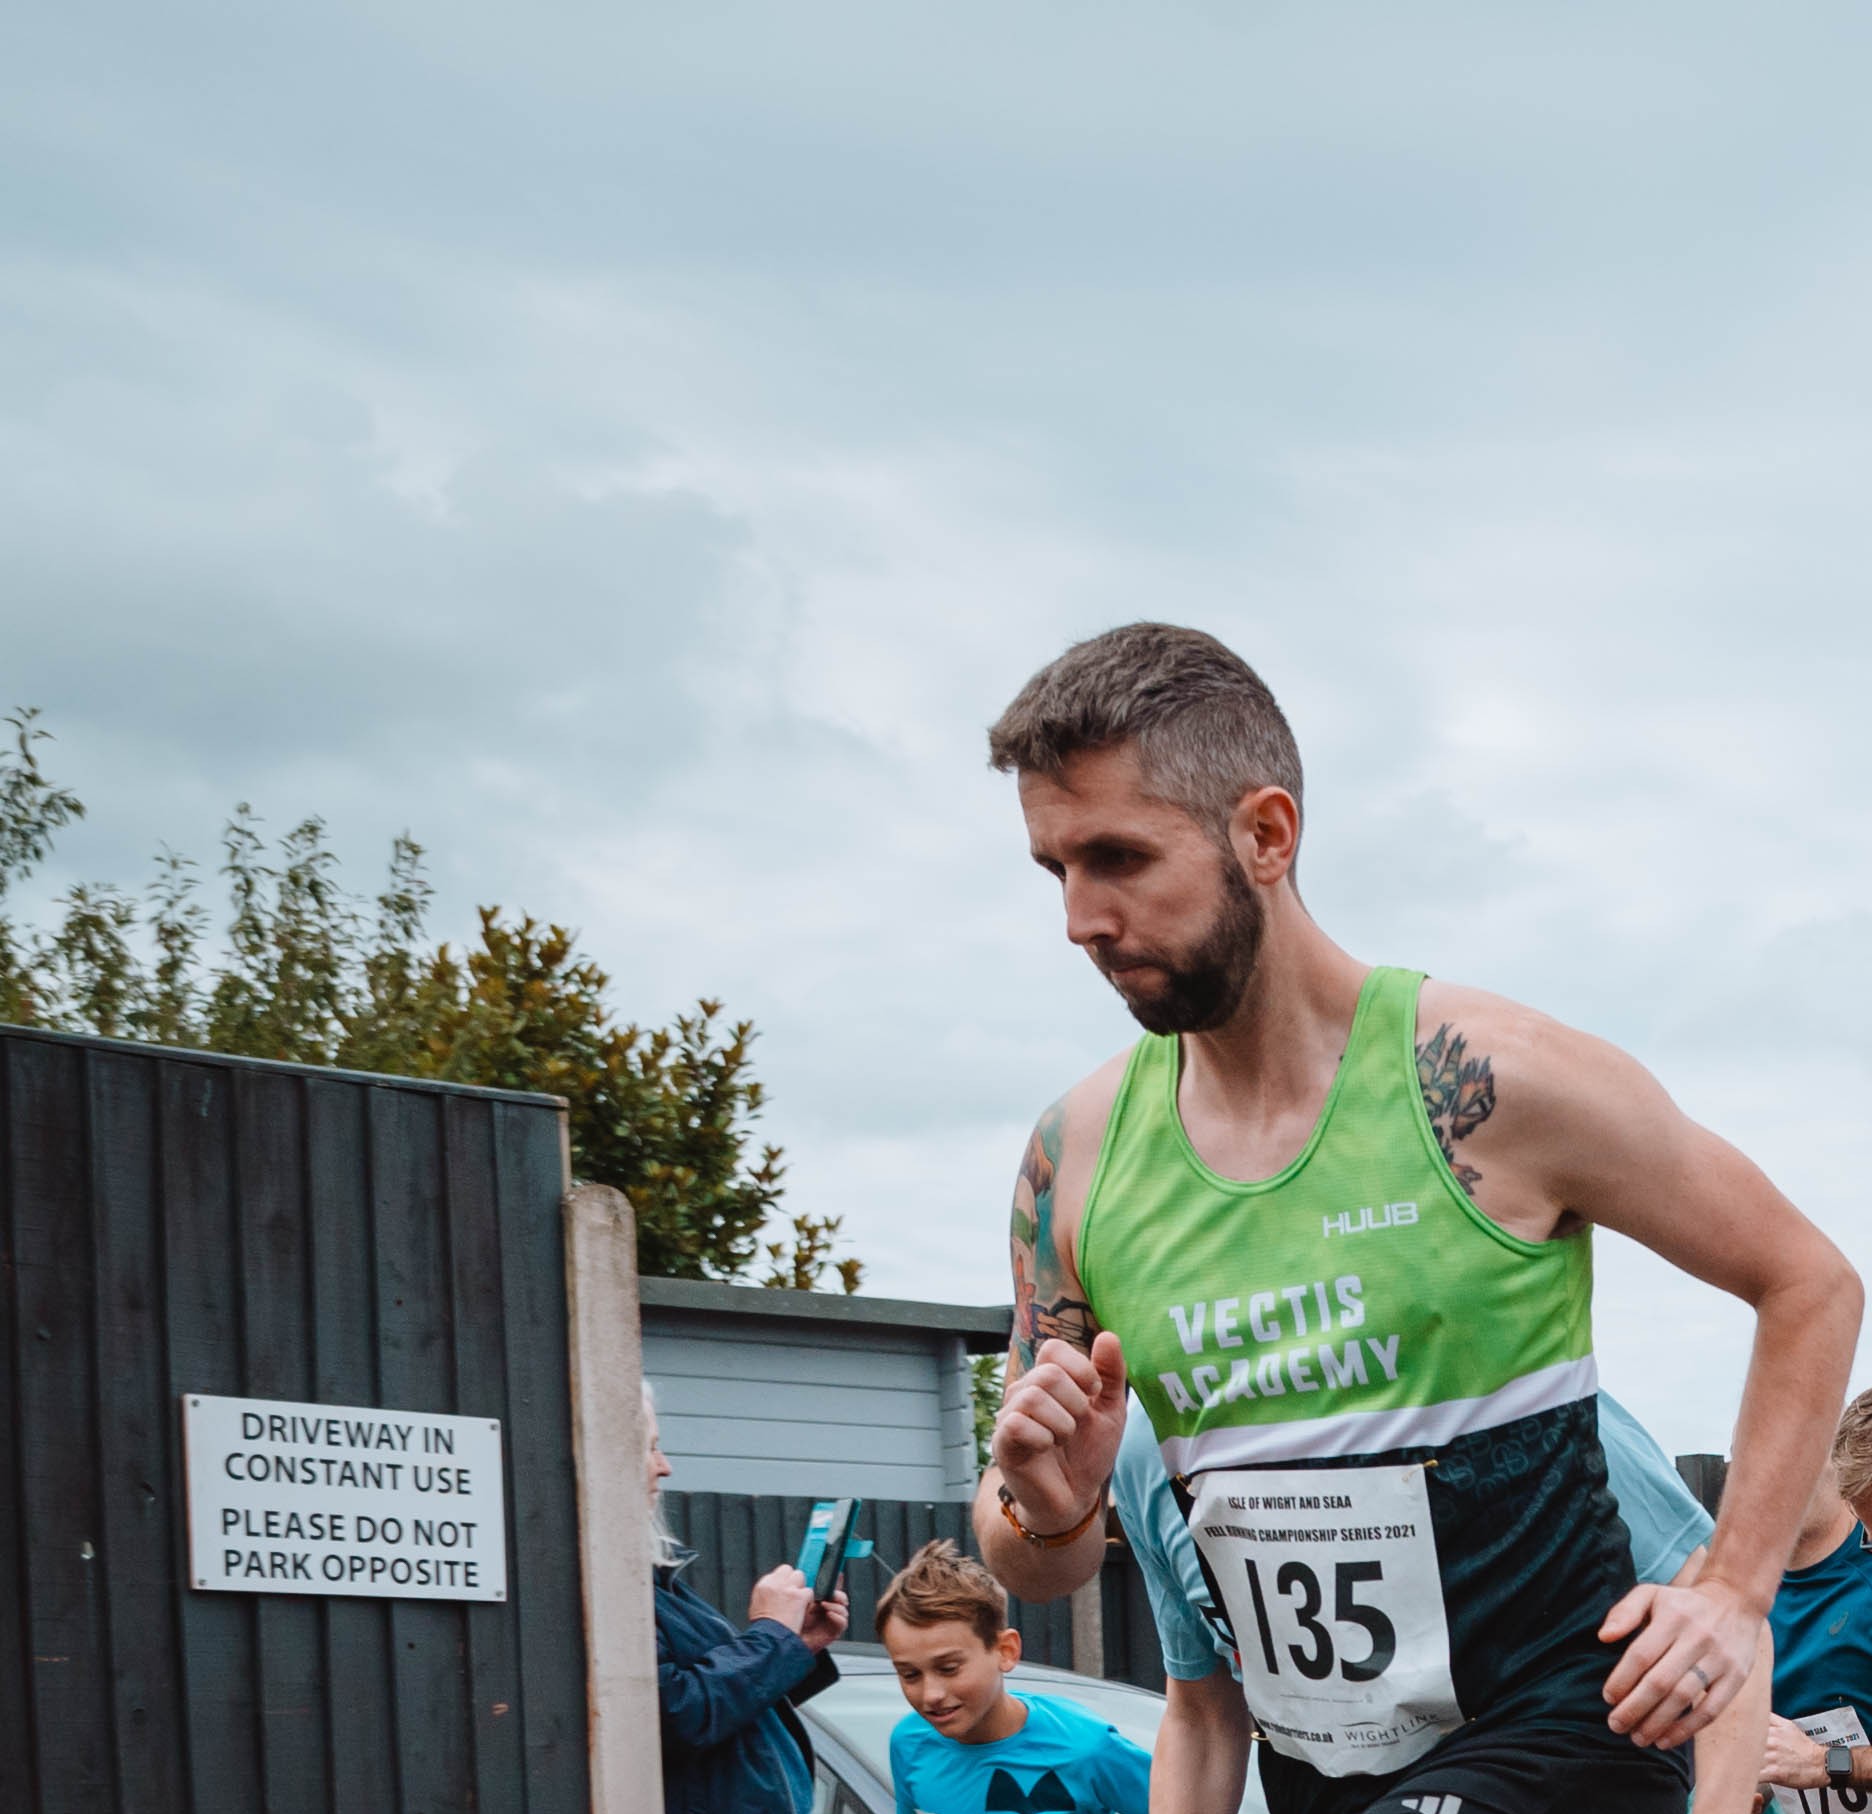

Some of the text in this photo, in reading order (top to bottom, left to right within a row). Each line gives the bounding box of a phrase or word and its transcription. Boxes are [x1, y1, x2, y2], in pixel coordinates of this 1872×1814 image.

[1322, 1201, 1419, 1238] HUUB
[1168, 1274, 1365, 1355] VECTIS
[1158, 1334, 1400, 1414] ACADEMY
[242, 1412, 454, 1455] DRIVEWAY IN
[225, 1452, 472, 1495] CONSTANT USE
[1249, 1496, 1261, 1509] OF
[1262, 1496, 1297, 1509] WIGHT
[1299, 1496, 1320, 1509] AND
[1323, 1495, 1352, 1509] SEAA
[222, 1508, 477, 1548] PLEASE DO NOT
[1258, 1528, 1338, 1543] CHAMPIONSHIP
[1340, 1526, 1382, 1541] SERIES
[1385, 1524, 1417, 1540] 2021
[224, 1549, 479, 1588] PARK OPPOSITE
[1244, 1558, 1396, 1682] 135
